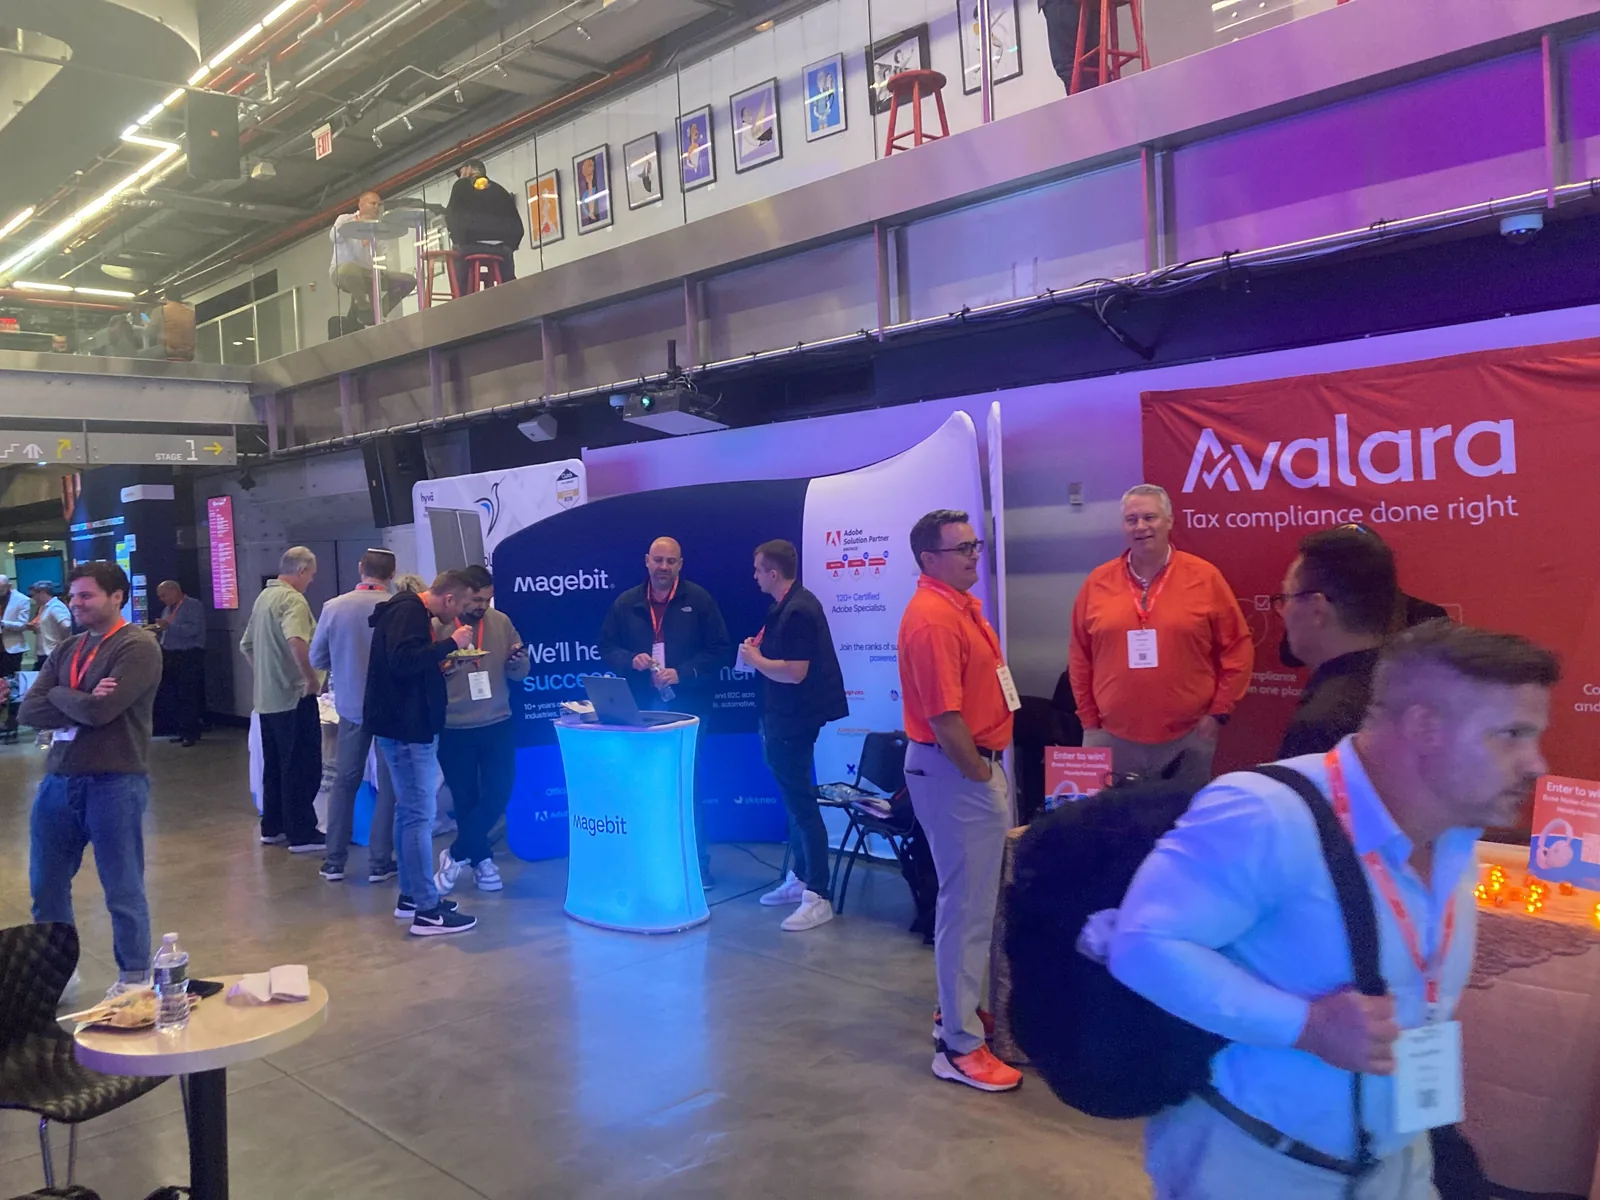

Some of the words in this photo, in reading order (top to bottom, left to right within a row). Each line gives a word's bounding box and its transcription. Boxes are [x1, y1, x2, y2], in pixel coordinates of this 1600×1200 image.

[155, 453, 183, 461] STAGE
[185, 440, 198, 461] 1
[1181, 413, 1517, 494] Avalara
[1182, 508, 1220, 529] Tax
[1225, 503, 1364, 532] compliance
[1370, 499, 1440, 523] done
[1447, 494, 1519, 525] right
[843, 529, 863, 537] Adobe
[843, 537, 868, 546] Solution
[868, 535, 889, 544] Partner
[836, 594, 852, 602] 120+
[853, 592, 880, 602] Certified
[832, 605, 853, 614] Adobe
[853, 603, 887, 614] Specialists
[839, 643, 853, 651] Join
[853, 643, 865, 651] the
[865, 643, 883, 651] ranks
[883, 642, 891, 651] of
[1258, 686, 1280, 695] one
[524, 703, 536, 711] 10+
[537, 702, 556, 711] years
[1053, 751, 1075, 760] Enter
[1546, 781, 1573, 794] Enter
[1575, 787, 1587, 797] to
